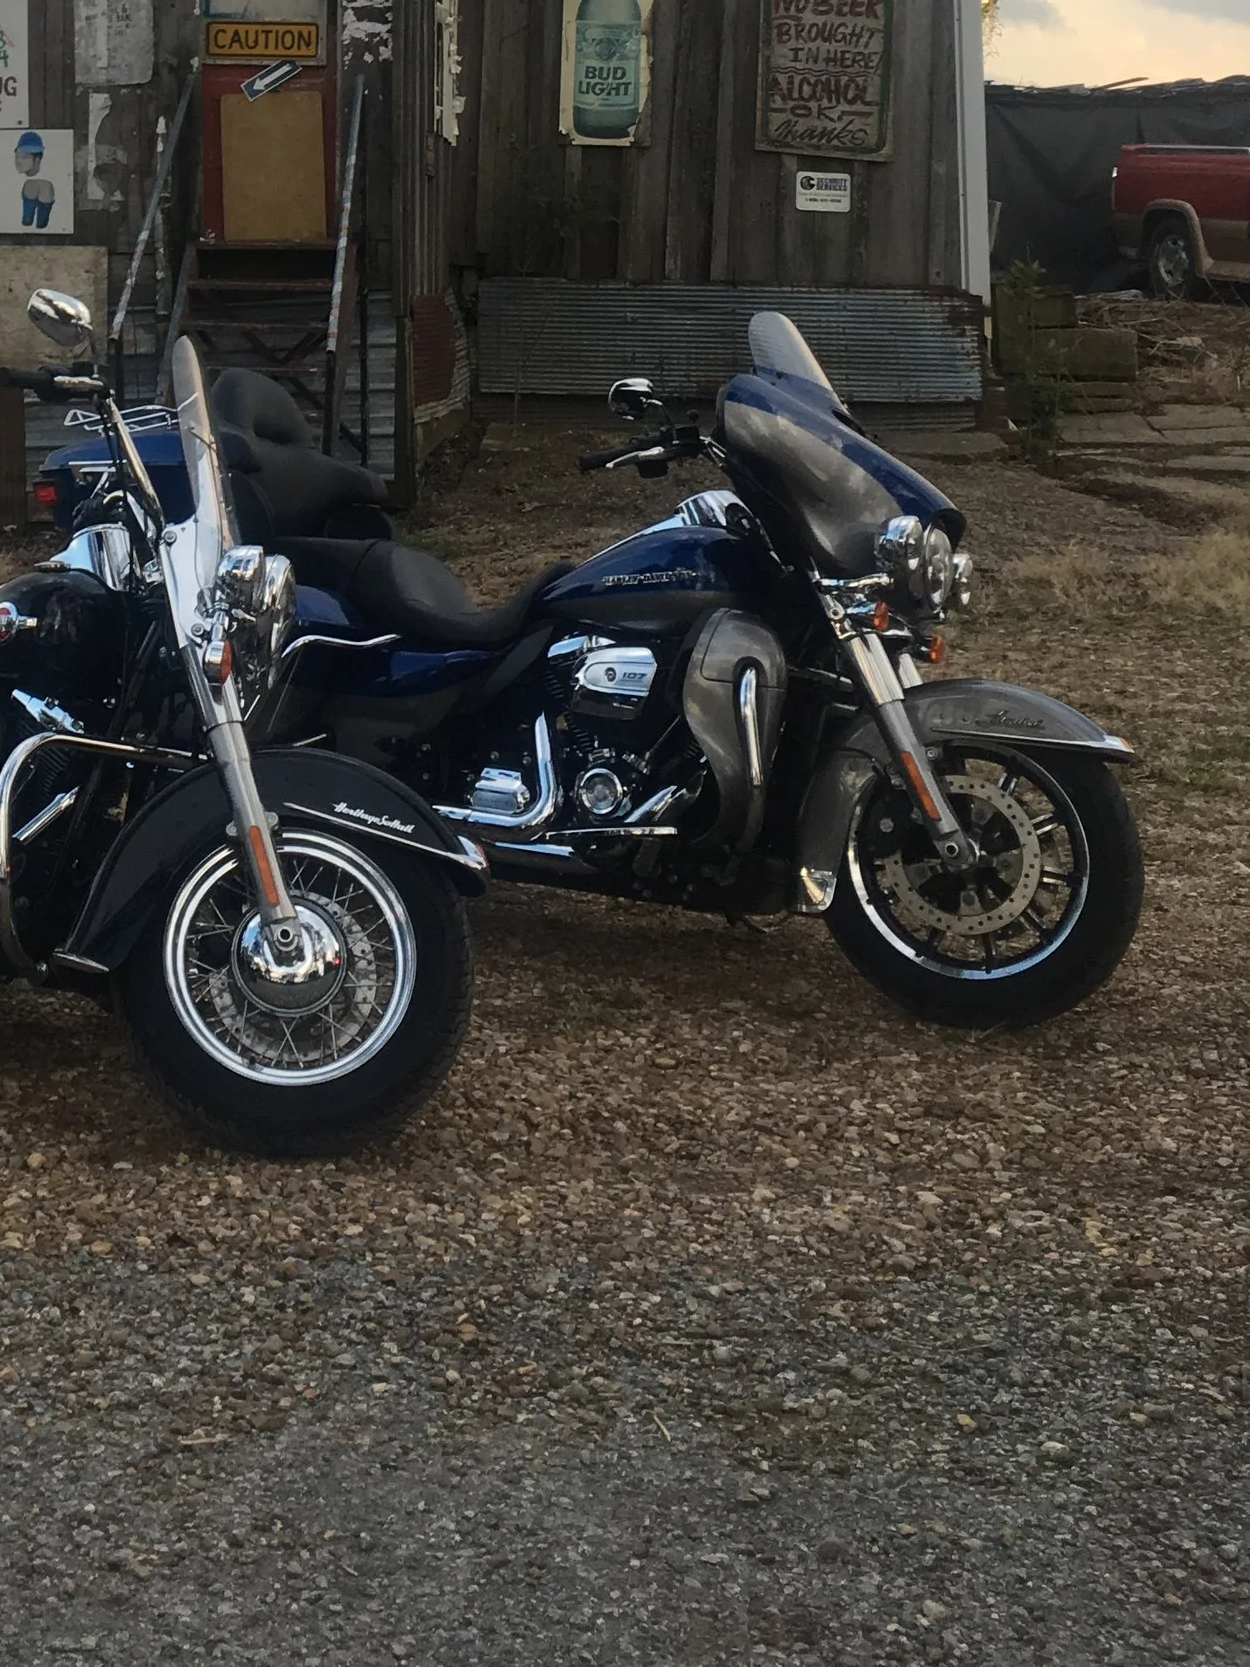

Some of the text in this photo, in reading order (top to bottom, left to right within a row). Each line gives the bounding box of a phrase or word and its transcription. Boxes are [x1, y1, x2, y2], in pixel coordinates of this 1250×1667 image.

[213, 28, 312, 51] CAUTION
[774, 20, 882, 49] BROUGHT
[788, 46, 820, 64] IN
[584, 65, 626, 80] BUD
[578, 82, 631, 97] LIGHT
[766, 75, 880, 105] ALCOHOL
